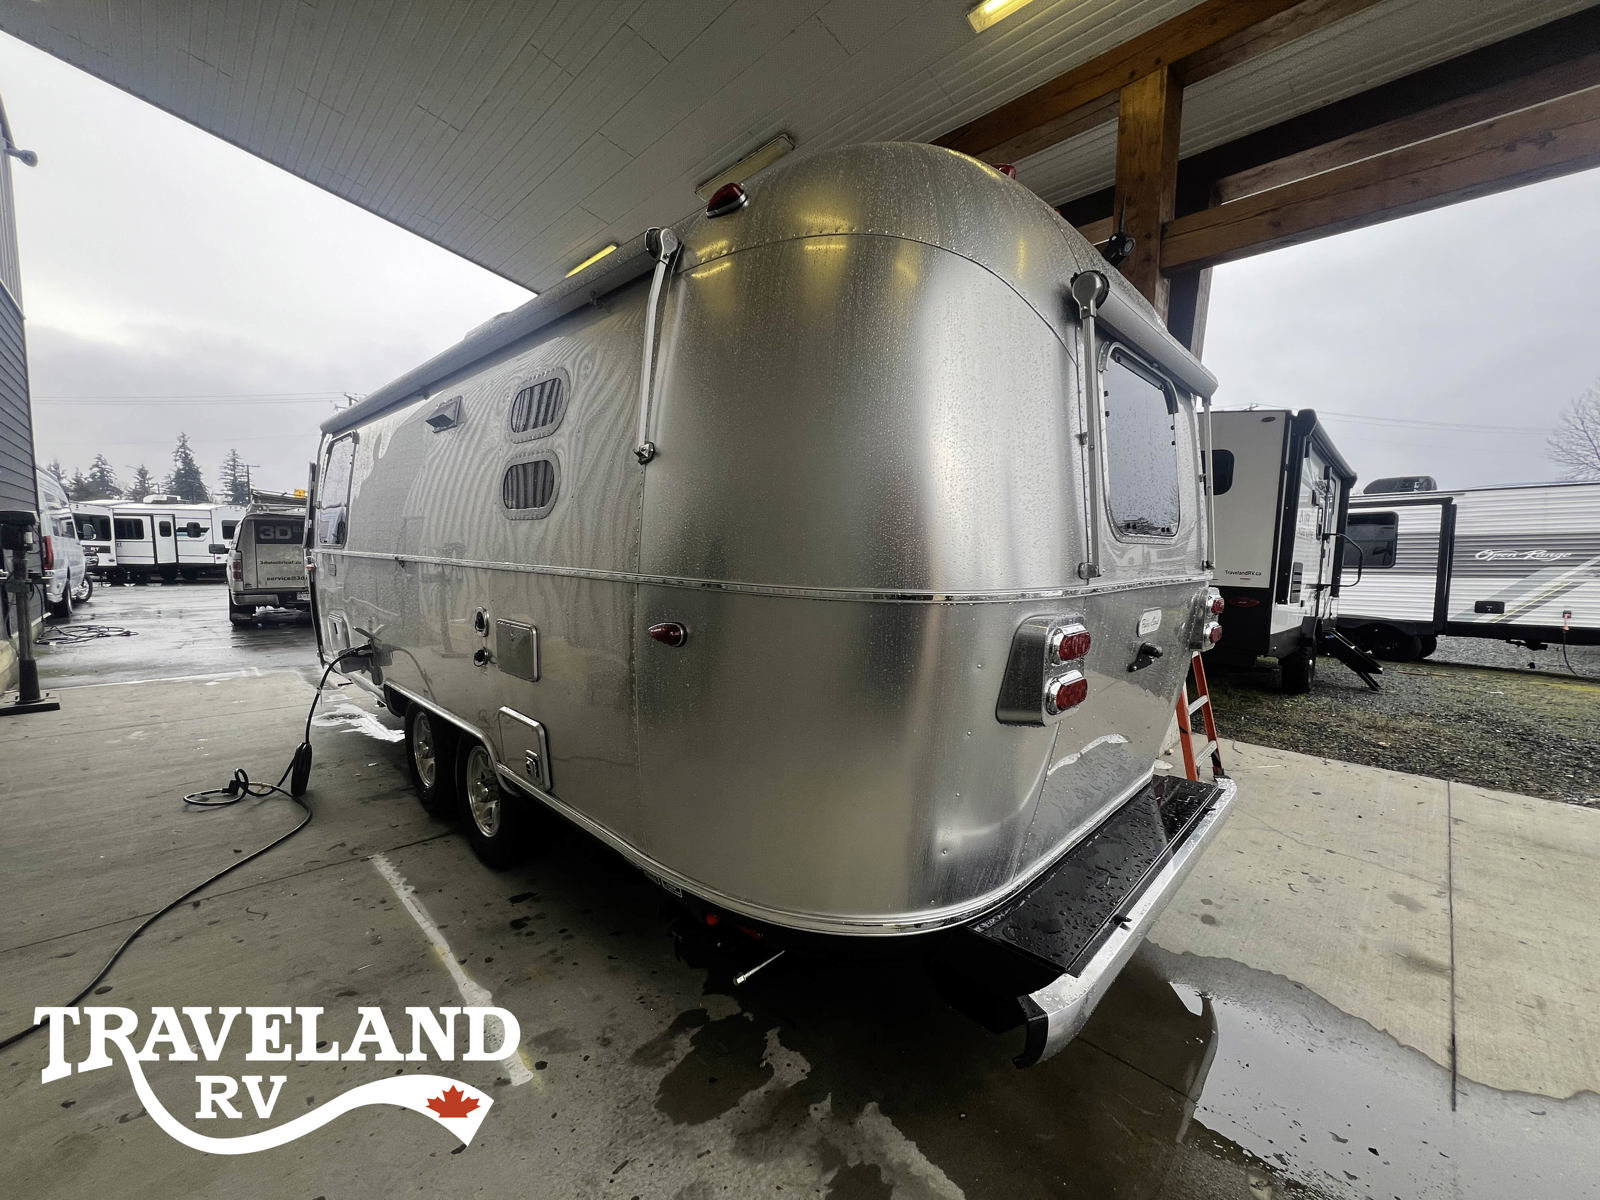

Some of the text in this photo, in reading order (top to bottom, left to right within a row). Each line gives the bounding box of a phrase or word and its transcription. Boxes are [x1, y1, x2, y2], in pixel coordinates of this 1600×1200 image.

[259, 525, 292, 540] 3D
[1475, 549, 1572, 562] Open Range
[1224, 569, 1262, 577] TravelandRV.ca
